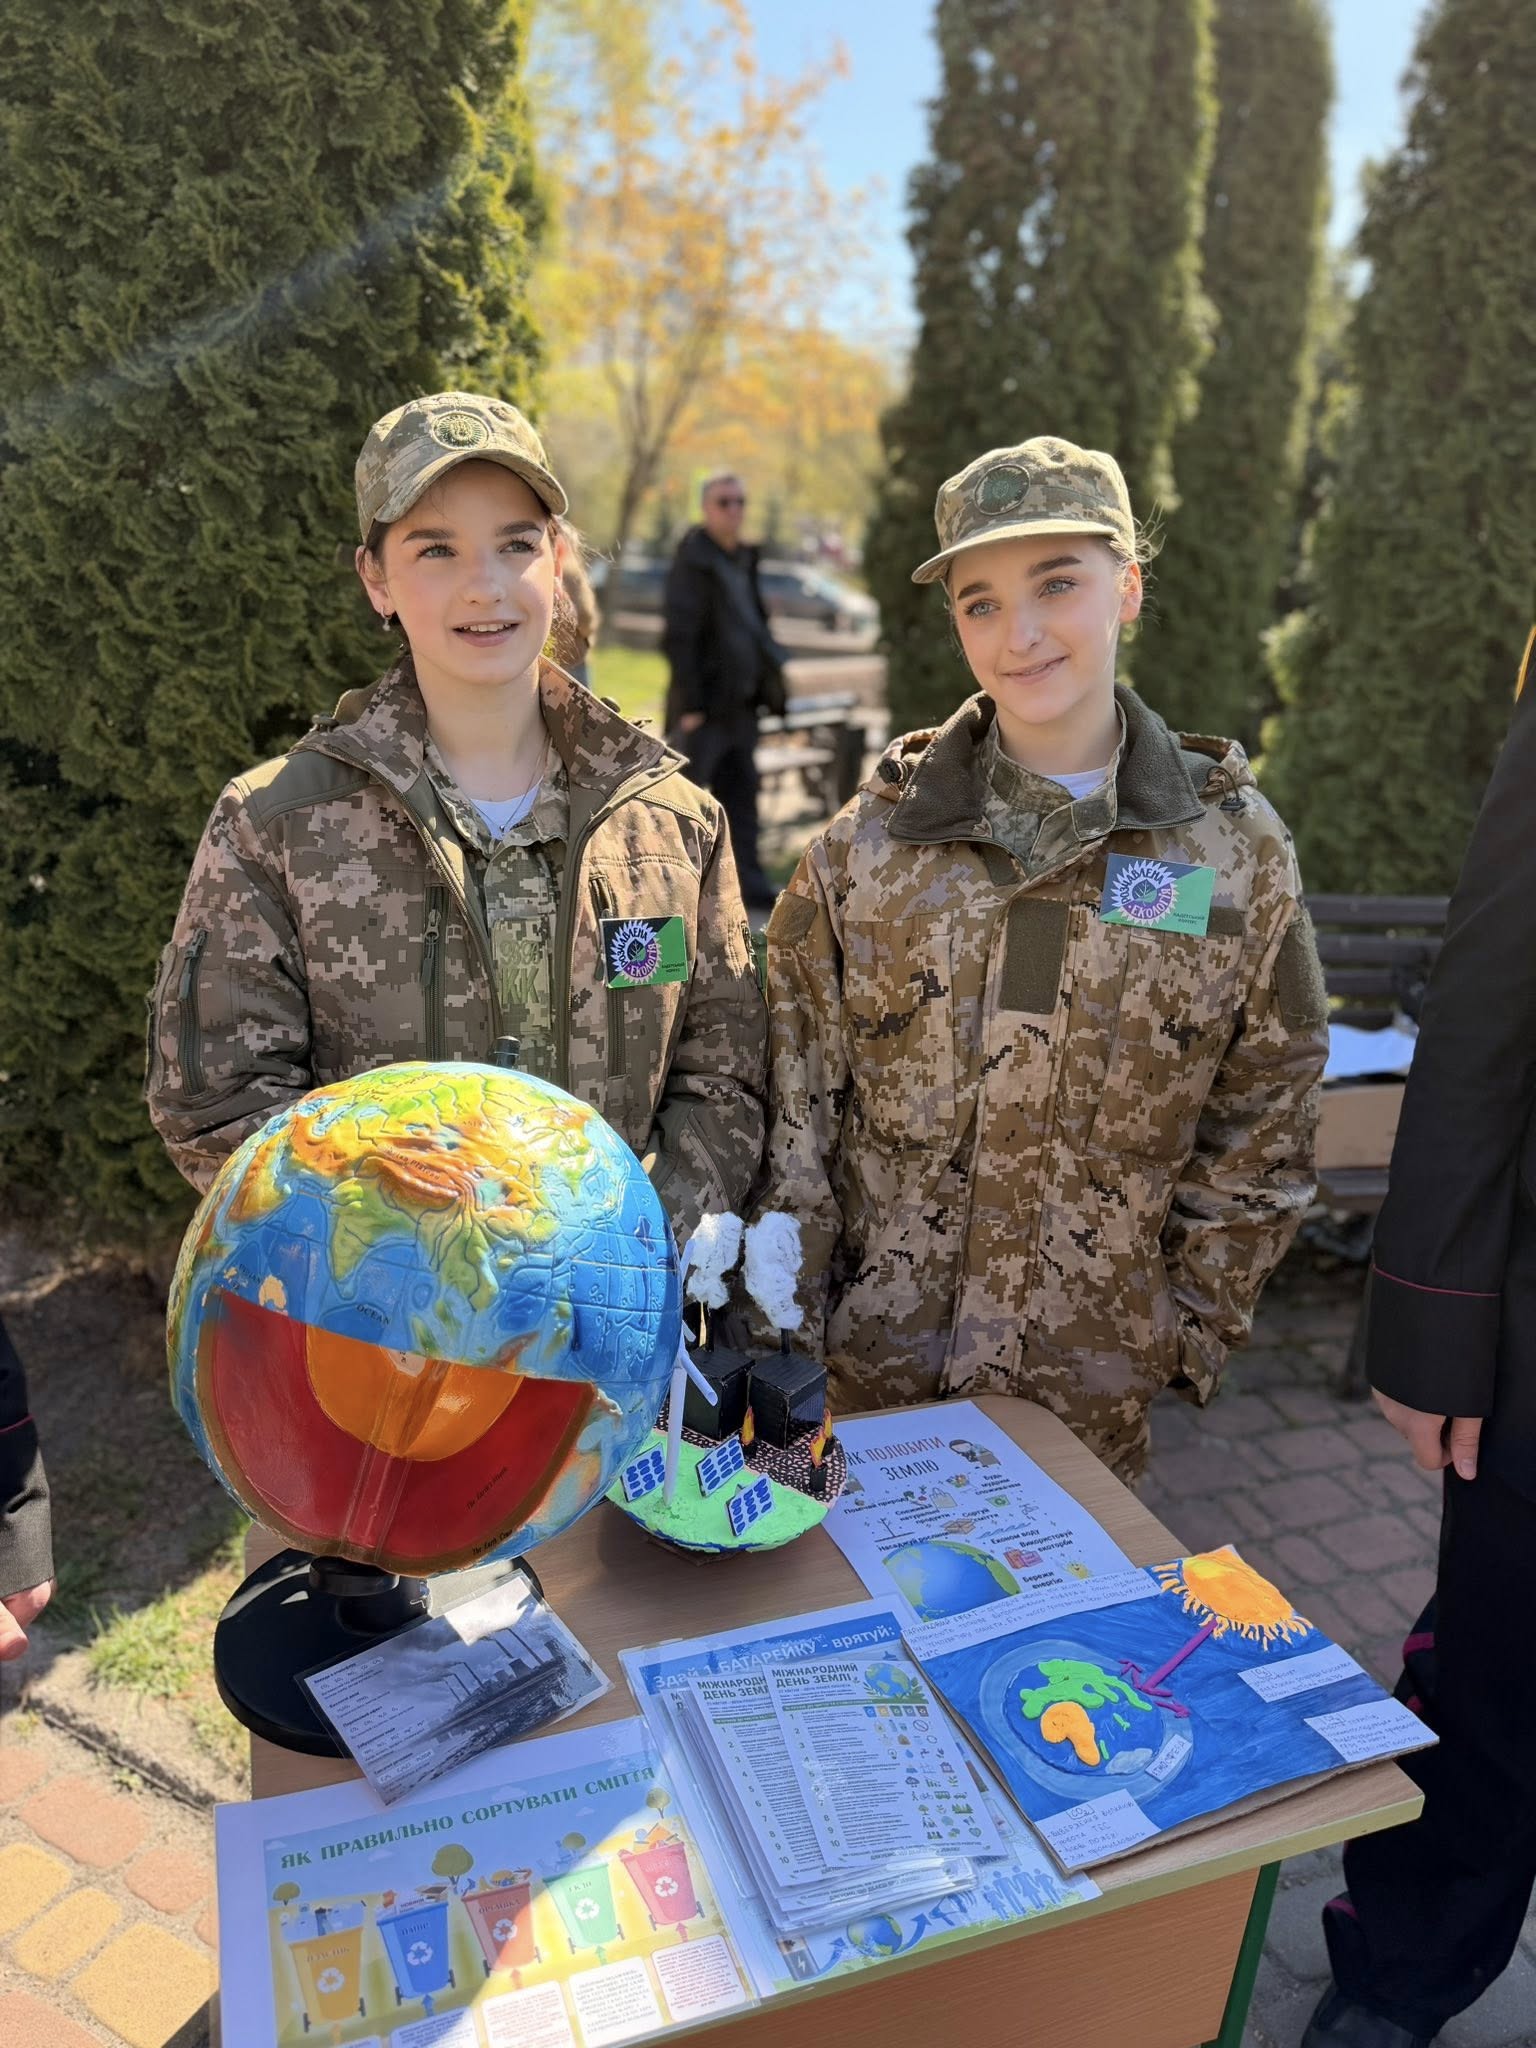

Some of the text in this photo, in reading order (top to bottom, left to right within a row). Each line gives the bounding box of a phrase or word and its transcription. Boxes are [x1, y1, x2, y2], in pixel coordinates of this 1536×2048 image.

[1131, 888, 1172, 918] ЕКОЛОГІЯ
[630, 943, 657, 977] ЕКОЛОГІЯ
[356, 1304, 390, 1325] OCEAN
[845, 1436, 946, 1467] ЯК ПОЛЮБИТИ
[880, 1459, 940, 1481] ЗЕМЛЮ
[990, 1533, 1020, 1545] Економ
[1019, 1529, 1074, 1548] Використовуй
[1022, 1570, 1055, 1583] Бережи
[717, 1641, 817, 1674] БАТАРЕЙКУ
[832, 1624, 896, 1651] врятуй:
[771, 1662, 859, 1678] МІЖНАРОДНИЙ
[697, 1675, 767, 1690] МІЖНАРОДН
[776, 1673, 852, 1689] ДЕНЬ ЗЕМЛІ
[703, 1689, 737, 1701] ДЕНЬ
[281, 1767, 656, 1869] ЯК ПРАВИЛЬНО СОРТУВАТИ СМІТТЯ
[1092, 1821, 1112, 1833] ТЕС
[830, 1840, 840, 1848] 10
[779, 1856, 790, 1865] 10
